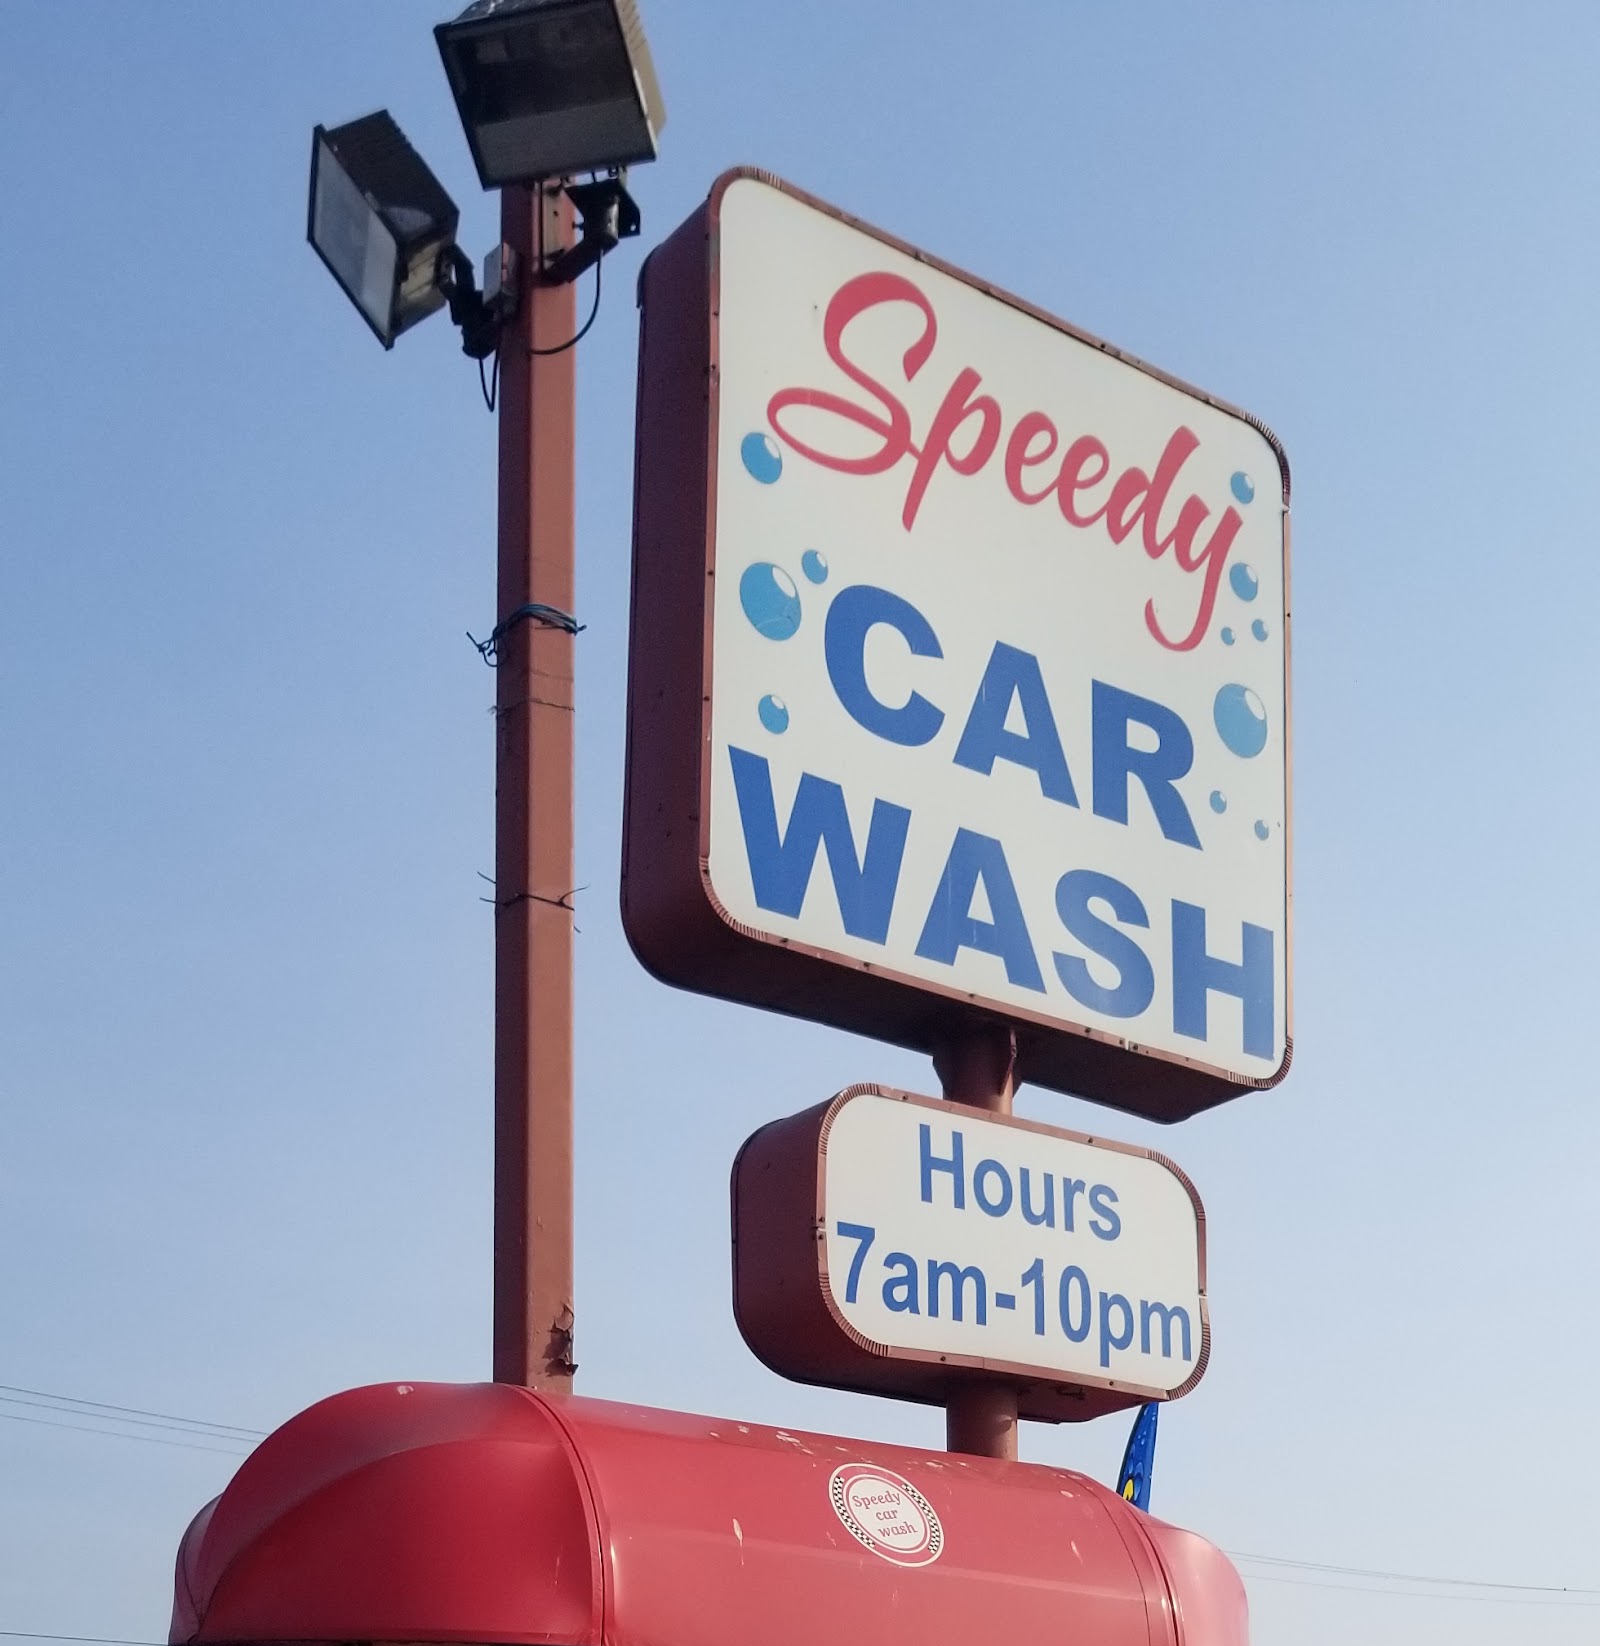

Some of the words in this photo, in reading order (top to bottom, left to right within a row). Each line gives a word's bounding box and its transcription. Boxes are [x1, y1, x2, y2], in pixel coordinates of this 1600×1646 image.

[767, 270, 1242, 652] Speedy
[823, 584, 1203, 851] CAR
[727, 745, 1274, 1061] WASH
[919, 1123, 1121, 1241] Hours
[836, 1221, 1192, 1368] 7am-10pm
[852, 1491, 901, 1509] Speedy
[875, 1509, 898, 1521] car
[878, 1521, 918, 1538] wash
